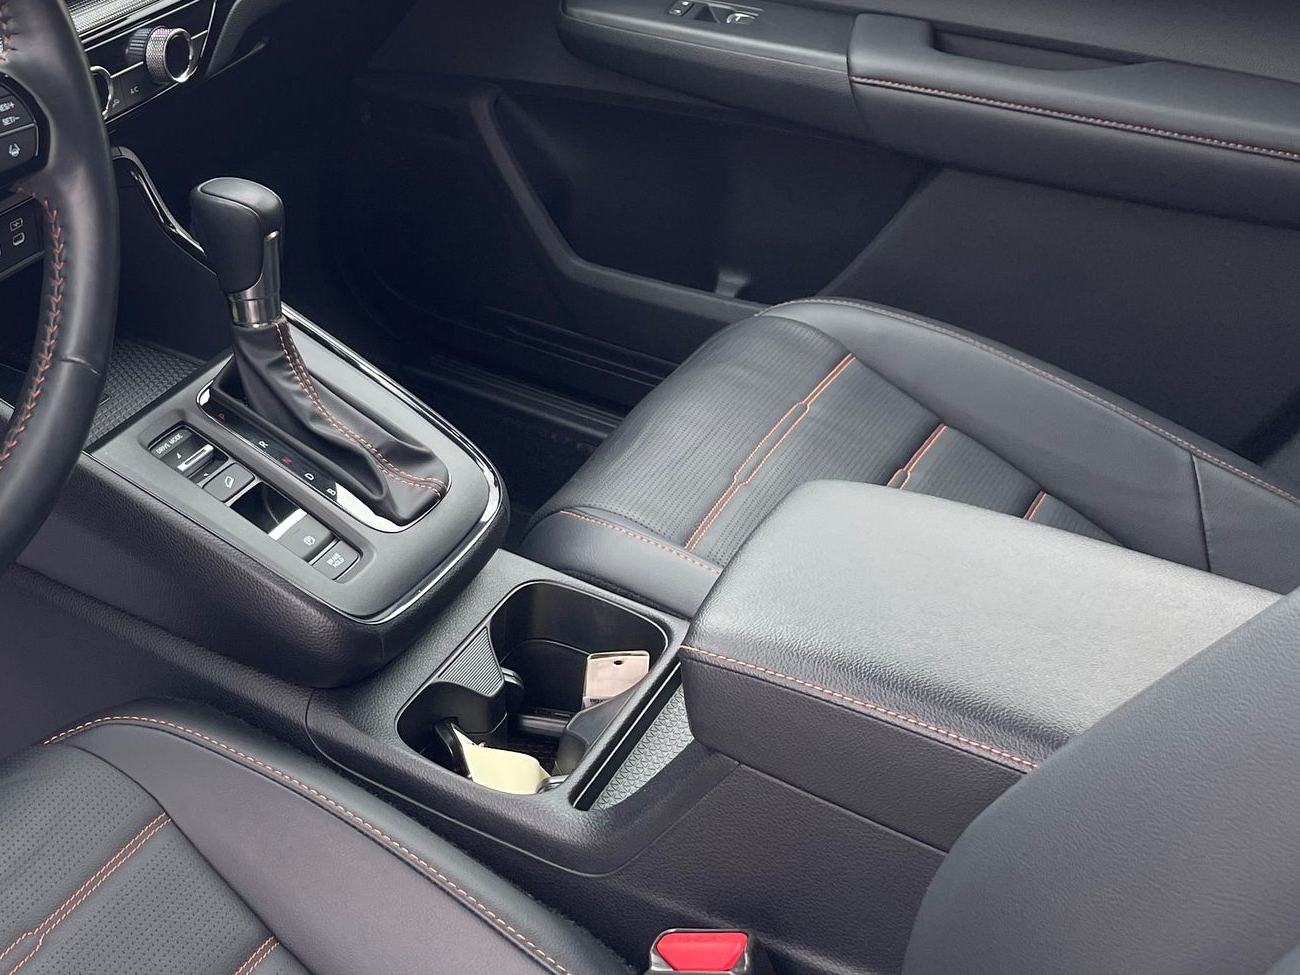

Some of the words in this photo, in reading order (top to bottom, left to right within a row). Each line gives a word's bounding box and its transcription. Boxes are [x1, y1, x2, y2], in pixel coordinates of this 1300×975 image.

[156, 442, 171, 454] DRIVE
[168, 433, 184, 445] MODE
[259, 440, 269, 449] R
[304, 472, 315, 481] D
[327, 488, 337, 496] B
